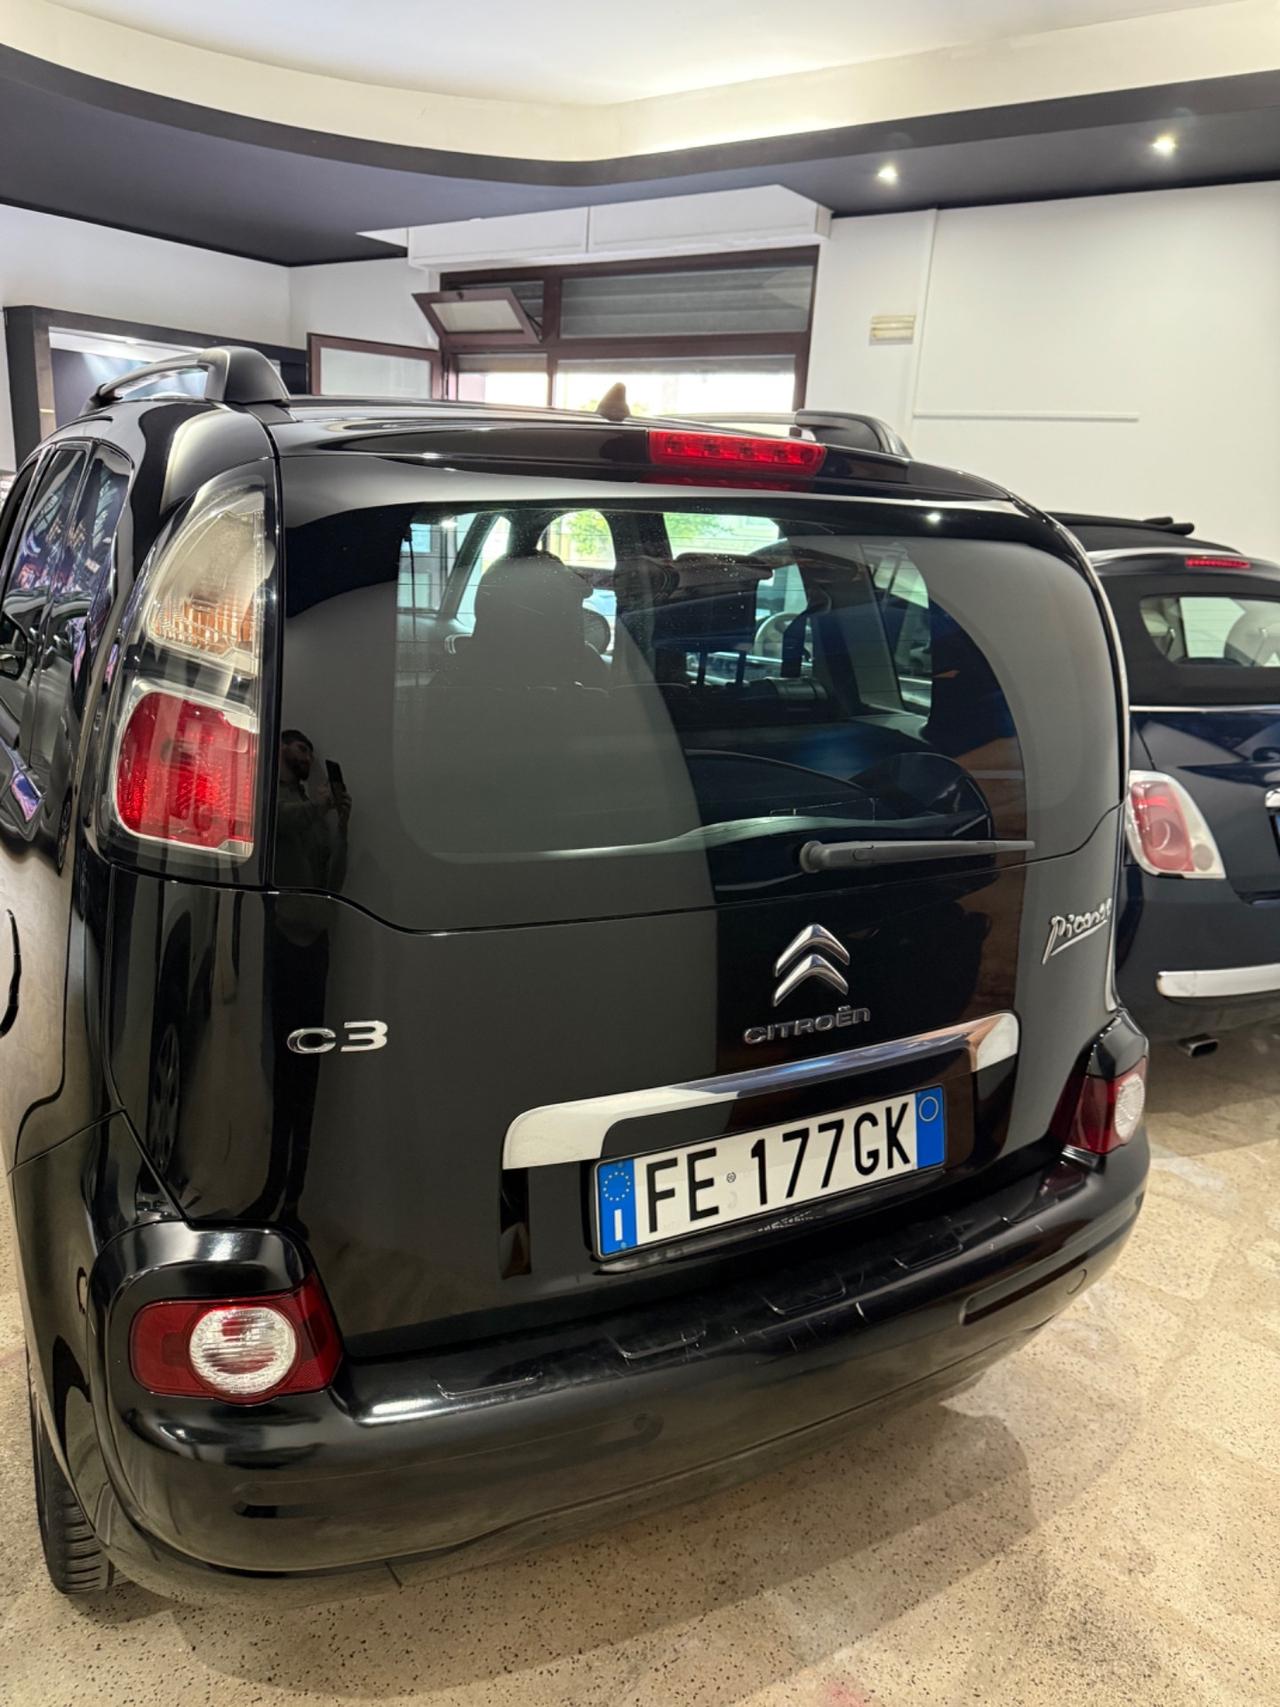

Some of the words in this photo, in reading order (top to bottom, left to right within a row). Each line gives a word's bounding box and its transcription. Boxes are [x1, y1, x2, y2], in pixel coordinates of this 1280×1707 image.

[286, 1020, 388, 1054] C3
[646, 1147, 720, 1234] FE
[750, 1101, 911, 1206] 177GK
